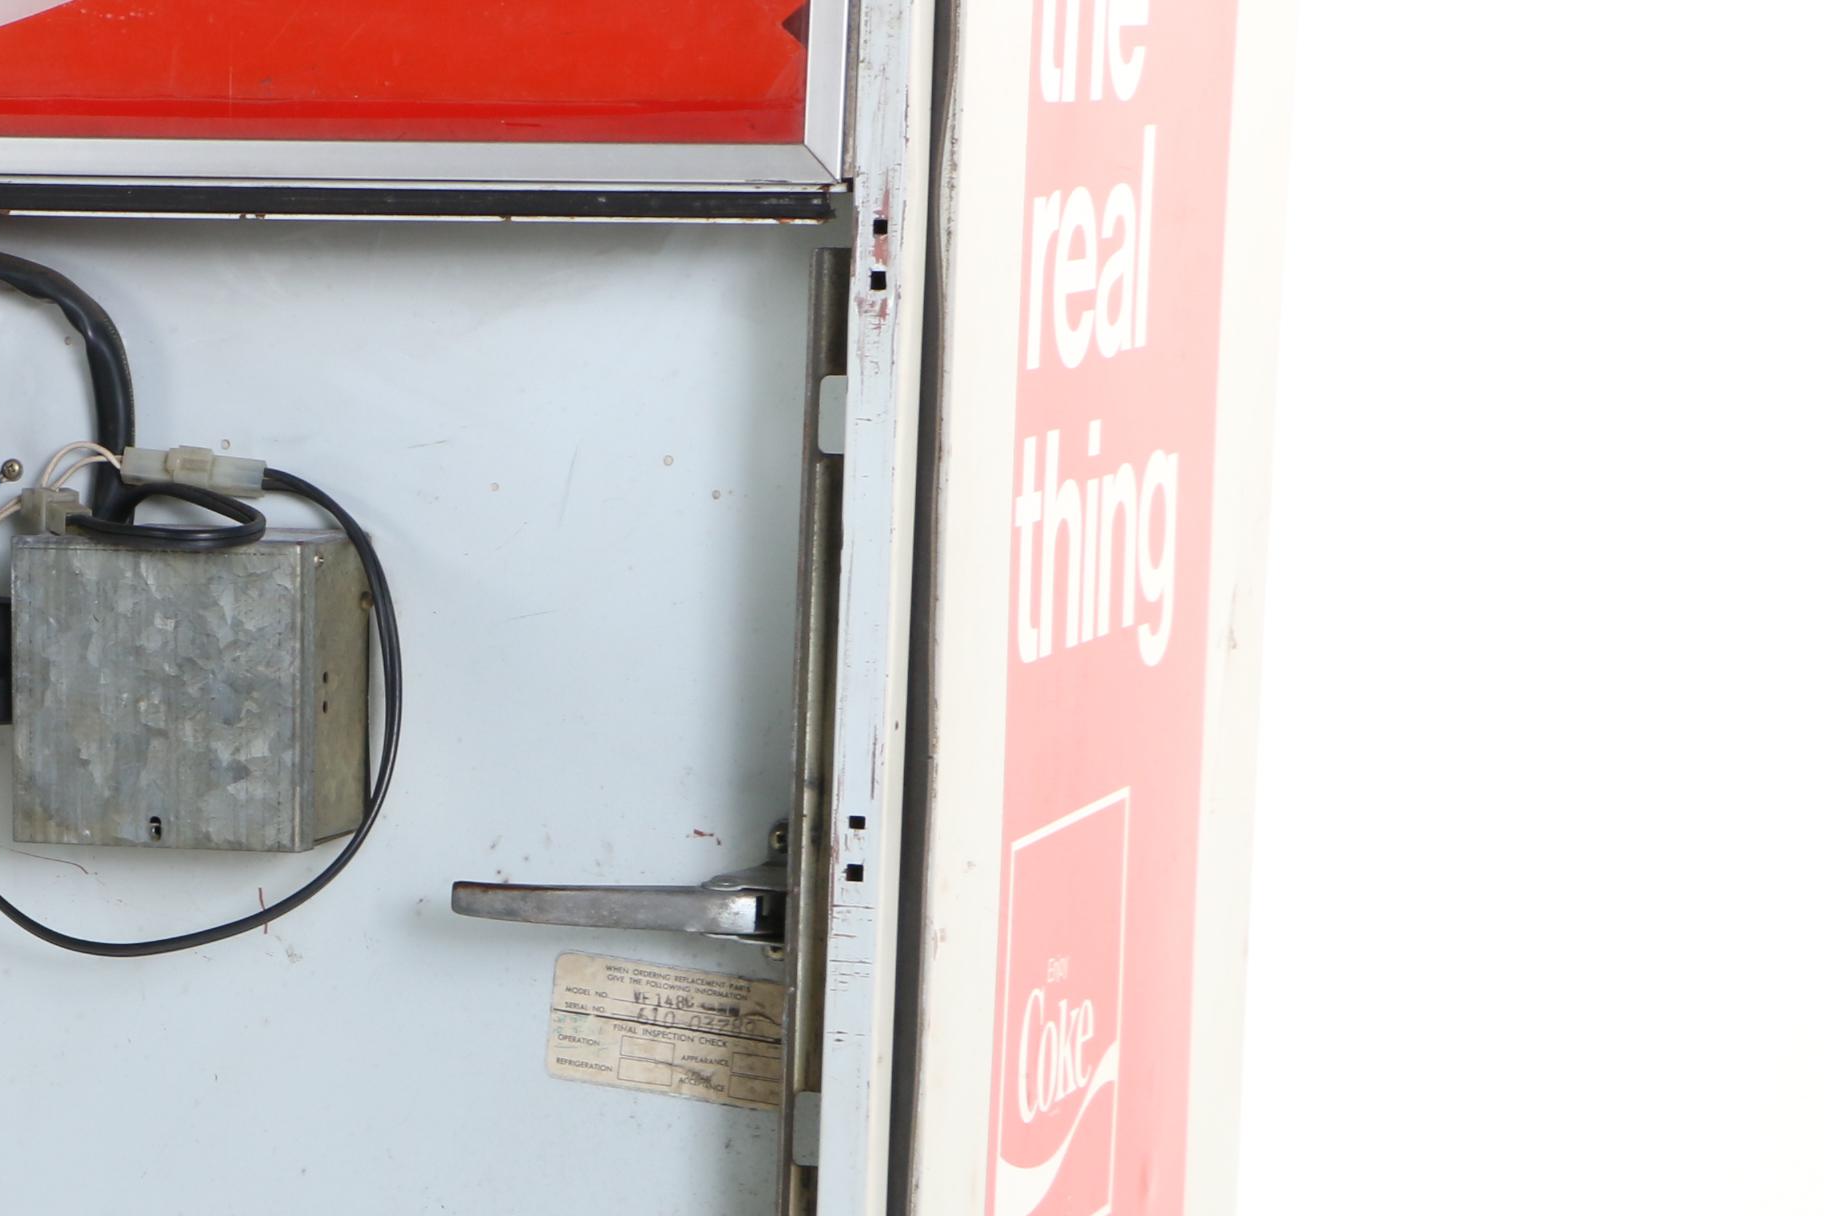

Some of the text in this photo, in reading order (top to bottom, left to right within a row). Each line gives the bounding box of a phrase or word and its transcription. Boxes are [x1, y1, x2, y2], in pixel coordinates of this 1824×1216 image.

[1027, 124, 1157, 370] real
[1015, 418, 1179, 667] thing
[605, 965, 629, 975] WHEN
[632, 968, 671, 982] ORDERING
[674, 974, 726, 989] REPLACEMENT
[606, 974, 749, 1001] GIVE THE FOLLOWING INFORMATION
[565, 986, 592, 997] MODEL
[564, 1001, 591, 1012] SERIAL
[557, 1034, 601, 1047] OPERATION
[612, 1023, 729, 1047] FINAL INSPECTION CHECK
[556, 1057, 613, 1072] REFRIGERATION
[1019, 986, 1094, 1123] Coke
